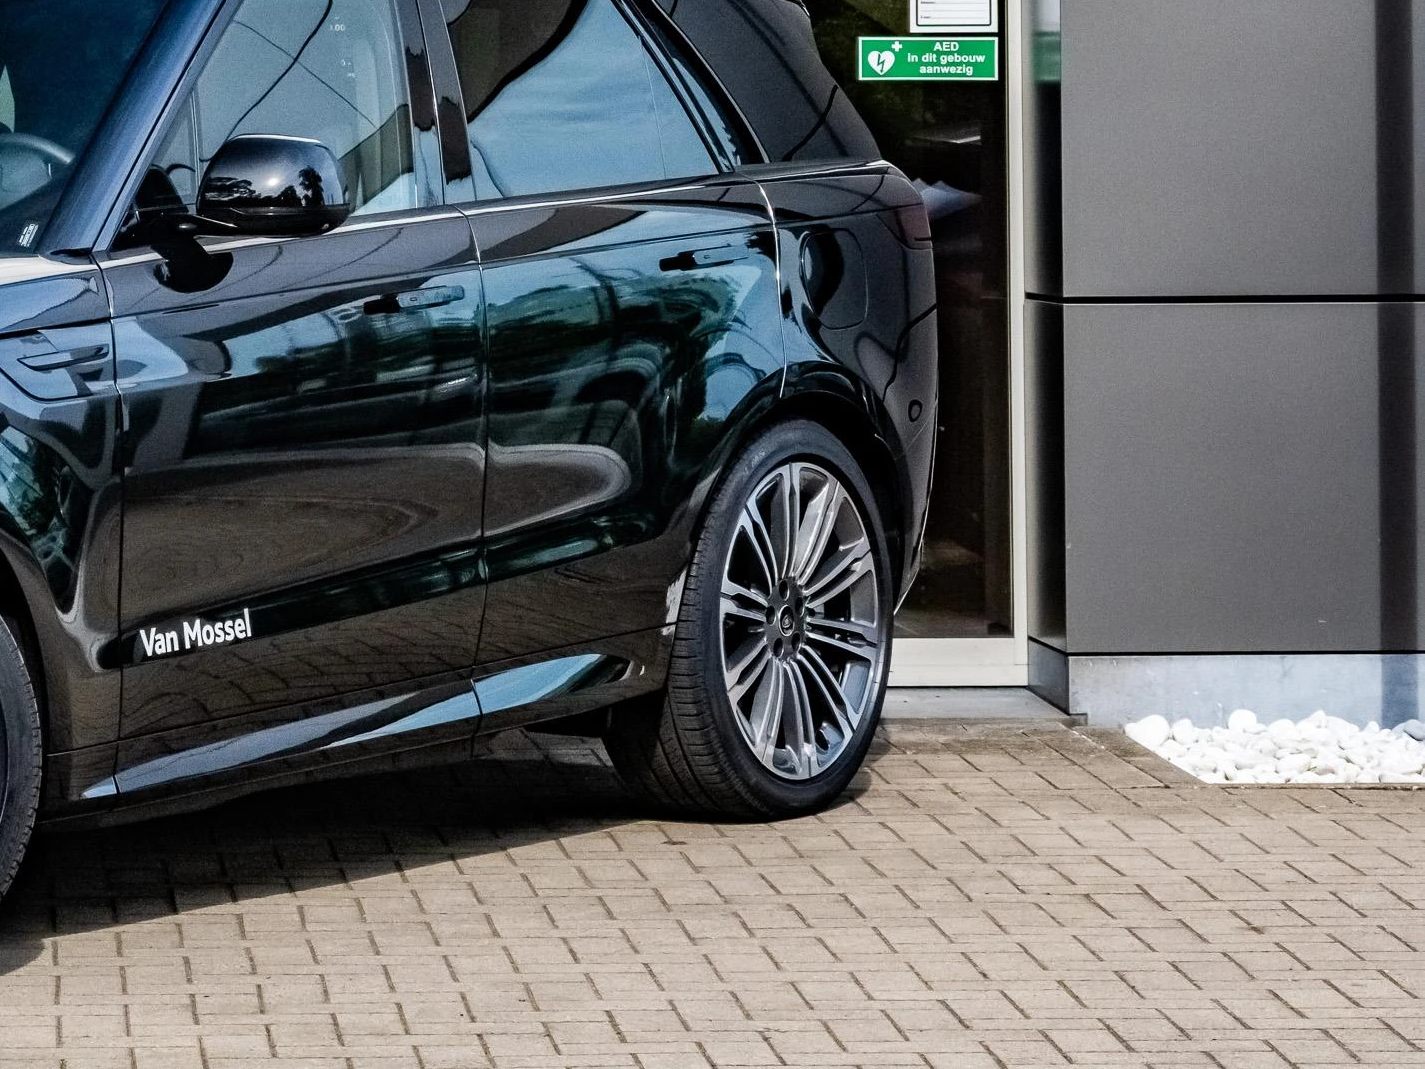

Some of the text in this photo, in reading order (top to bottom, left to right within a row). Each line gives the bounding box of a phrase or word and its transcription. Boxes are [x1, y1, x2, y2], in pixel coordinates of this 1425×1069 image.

[933, 42, 960, 51] AED
[922, 53, 937, 62] dit
[940, 53, 986, 65] gebouw
[919, 64, 973, 76] aanwezig
[140, 607, 251, 657] Van Mossel
